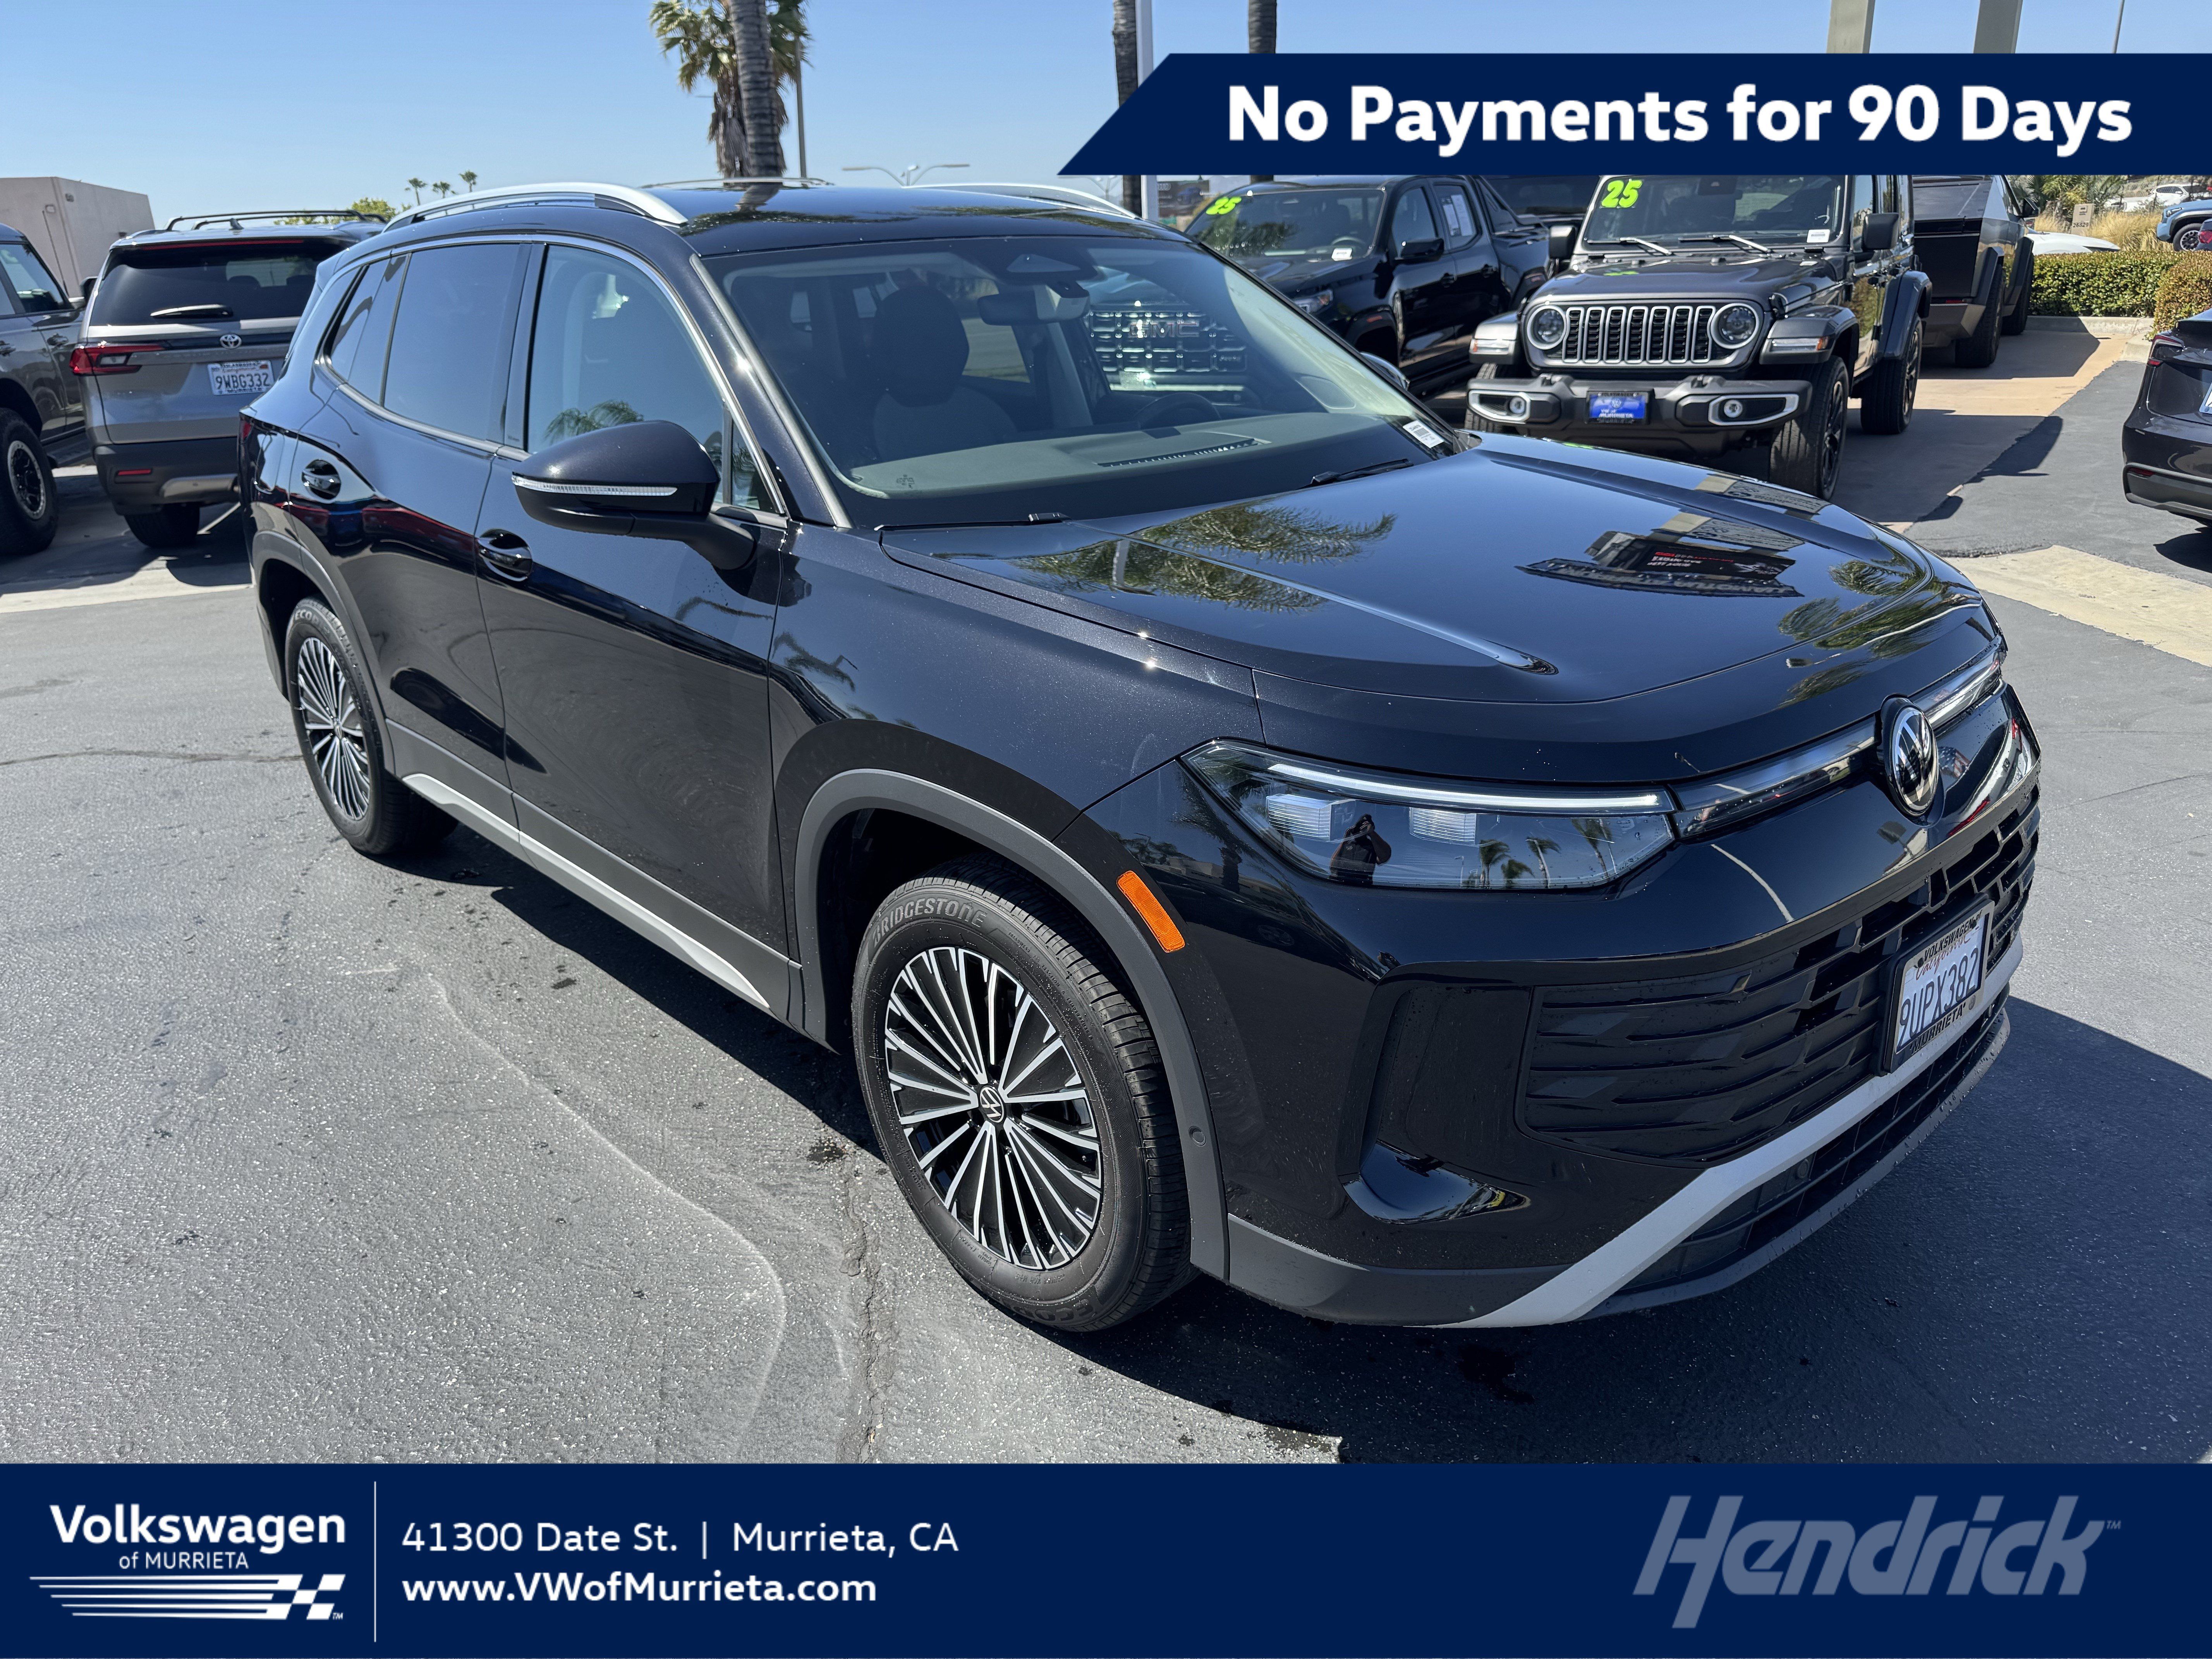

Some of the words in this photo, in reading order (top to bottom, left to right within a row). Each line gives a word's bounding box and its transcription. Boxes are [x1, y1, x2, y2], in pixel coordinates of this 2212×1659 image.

[1206, 196, 1242, 215] 25
[1602, 179, 1642, 208] 25
[1128, 320, 1200, 338] GMC
[216, 372, 270, 389] 9WBG332
[873, 898, 988, 947] BRIDGESTONE
[1924, 922, 1973, 960] VOLKSWAGEN
[1897, 947, 1978, 1046] 9UPX382
[1913, 1007, 1963, 1055] MURRIETA
